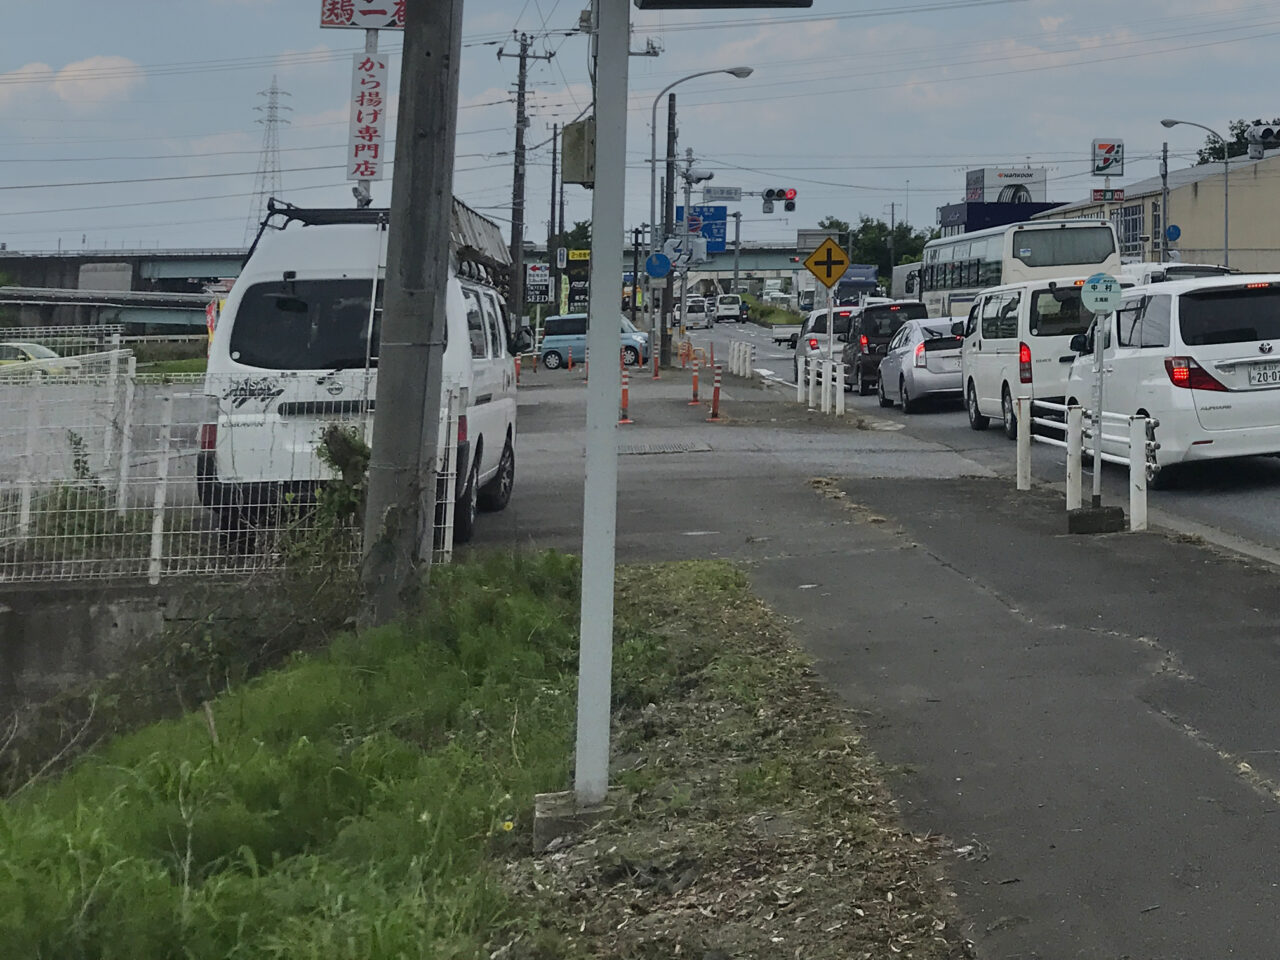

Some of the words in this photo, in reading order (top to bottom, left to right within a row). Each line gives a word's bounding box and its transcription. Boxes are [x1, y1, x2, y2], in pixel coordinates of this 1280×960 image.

[352, 57, 385, 177] から揚げ専門店
